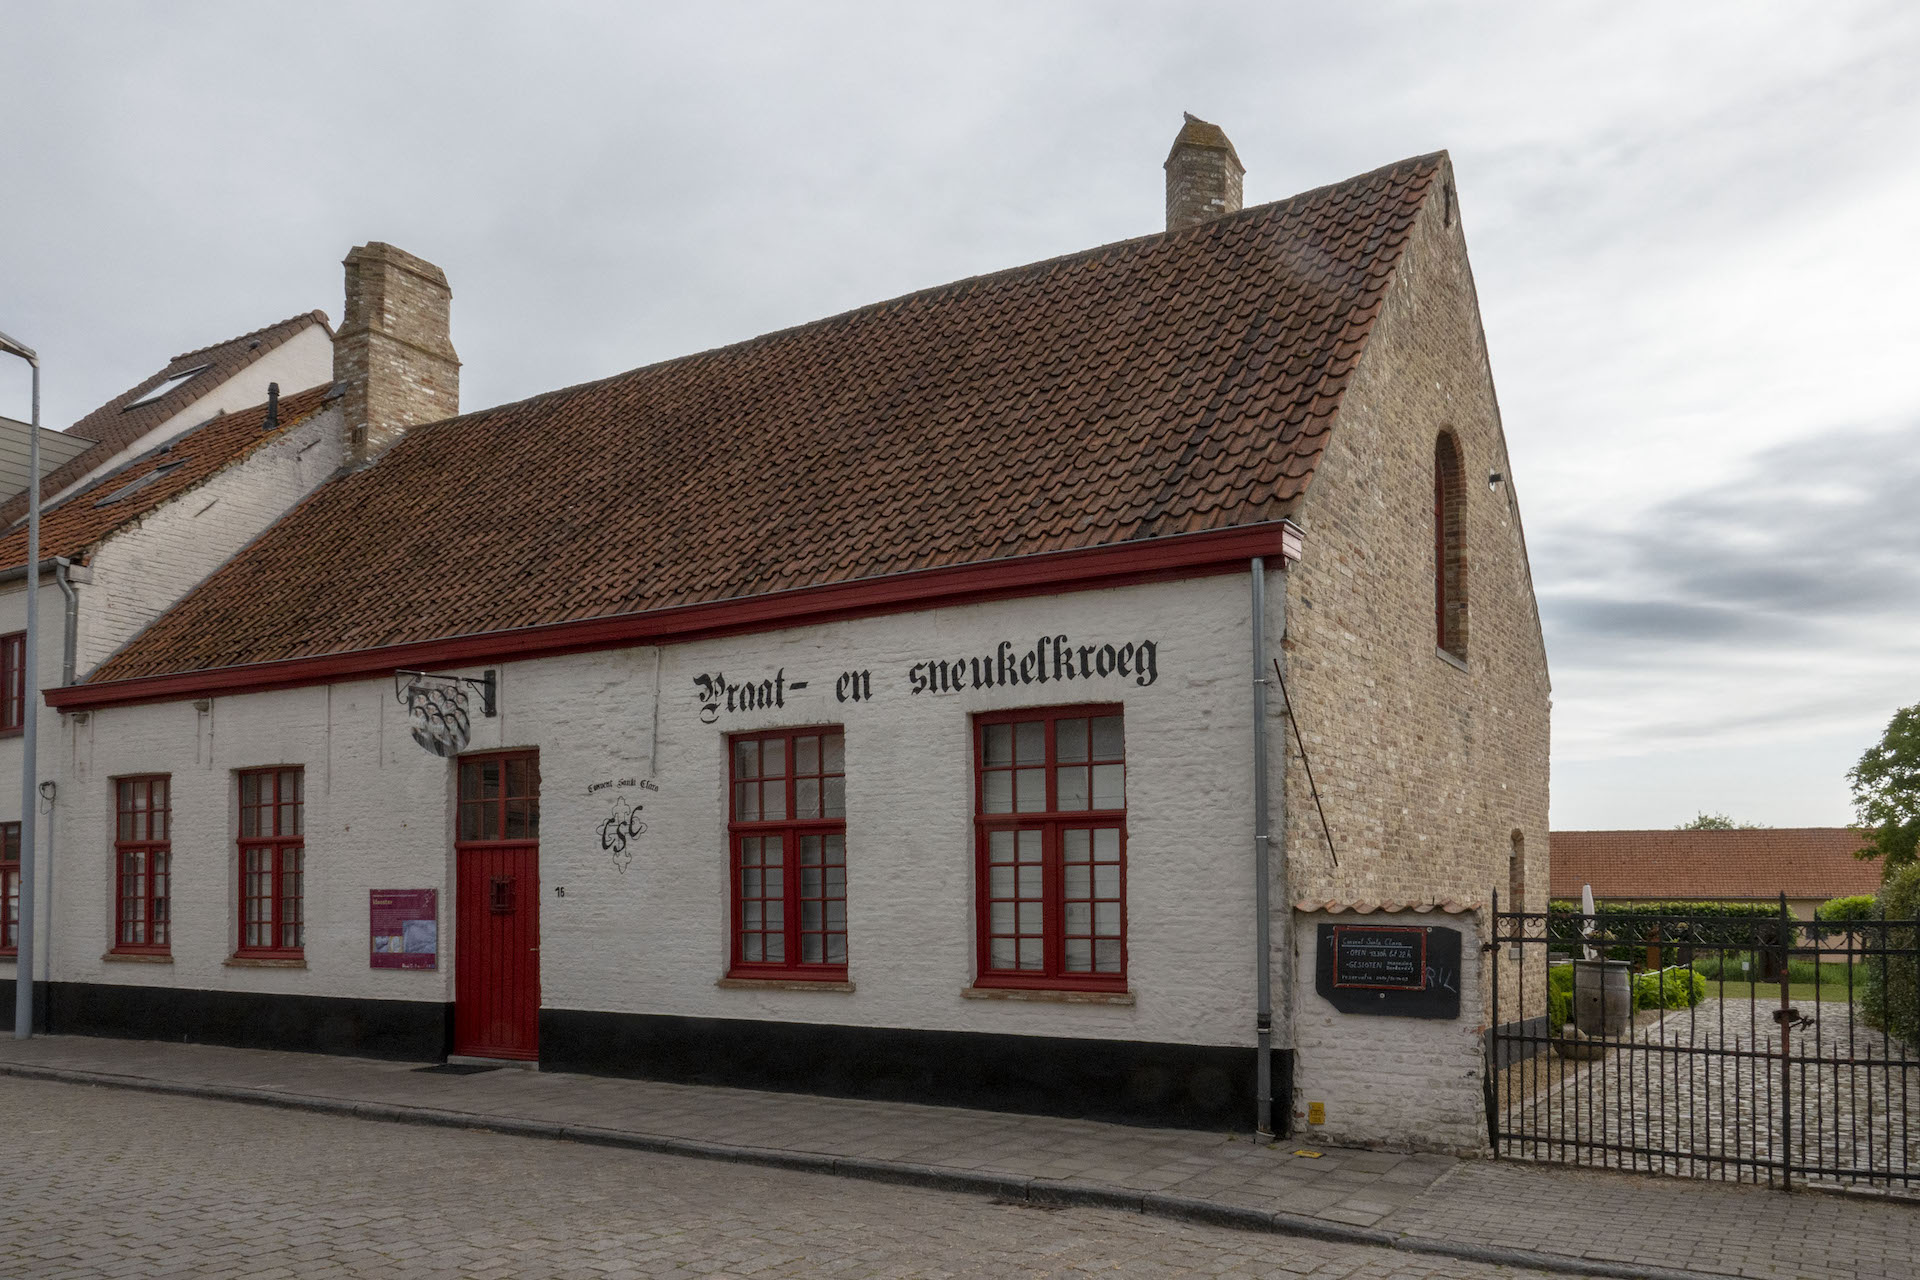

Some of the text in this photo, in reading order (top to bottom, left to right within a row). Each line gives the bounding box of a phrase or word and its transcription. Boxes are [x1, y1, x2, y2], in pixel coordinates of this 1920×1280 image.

[692, 634, 1159, 724] Praat- en sneukelkroeg
